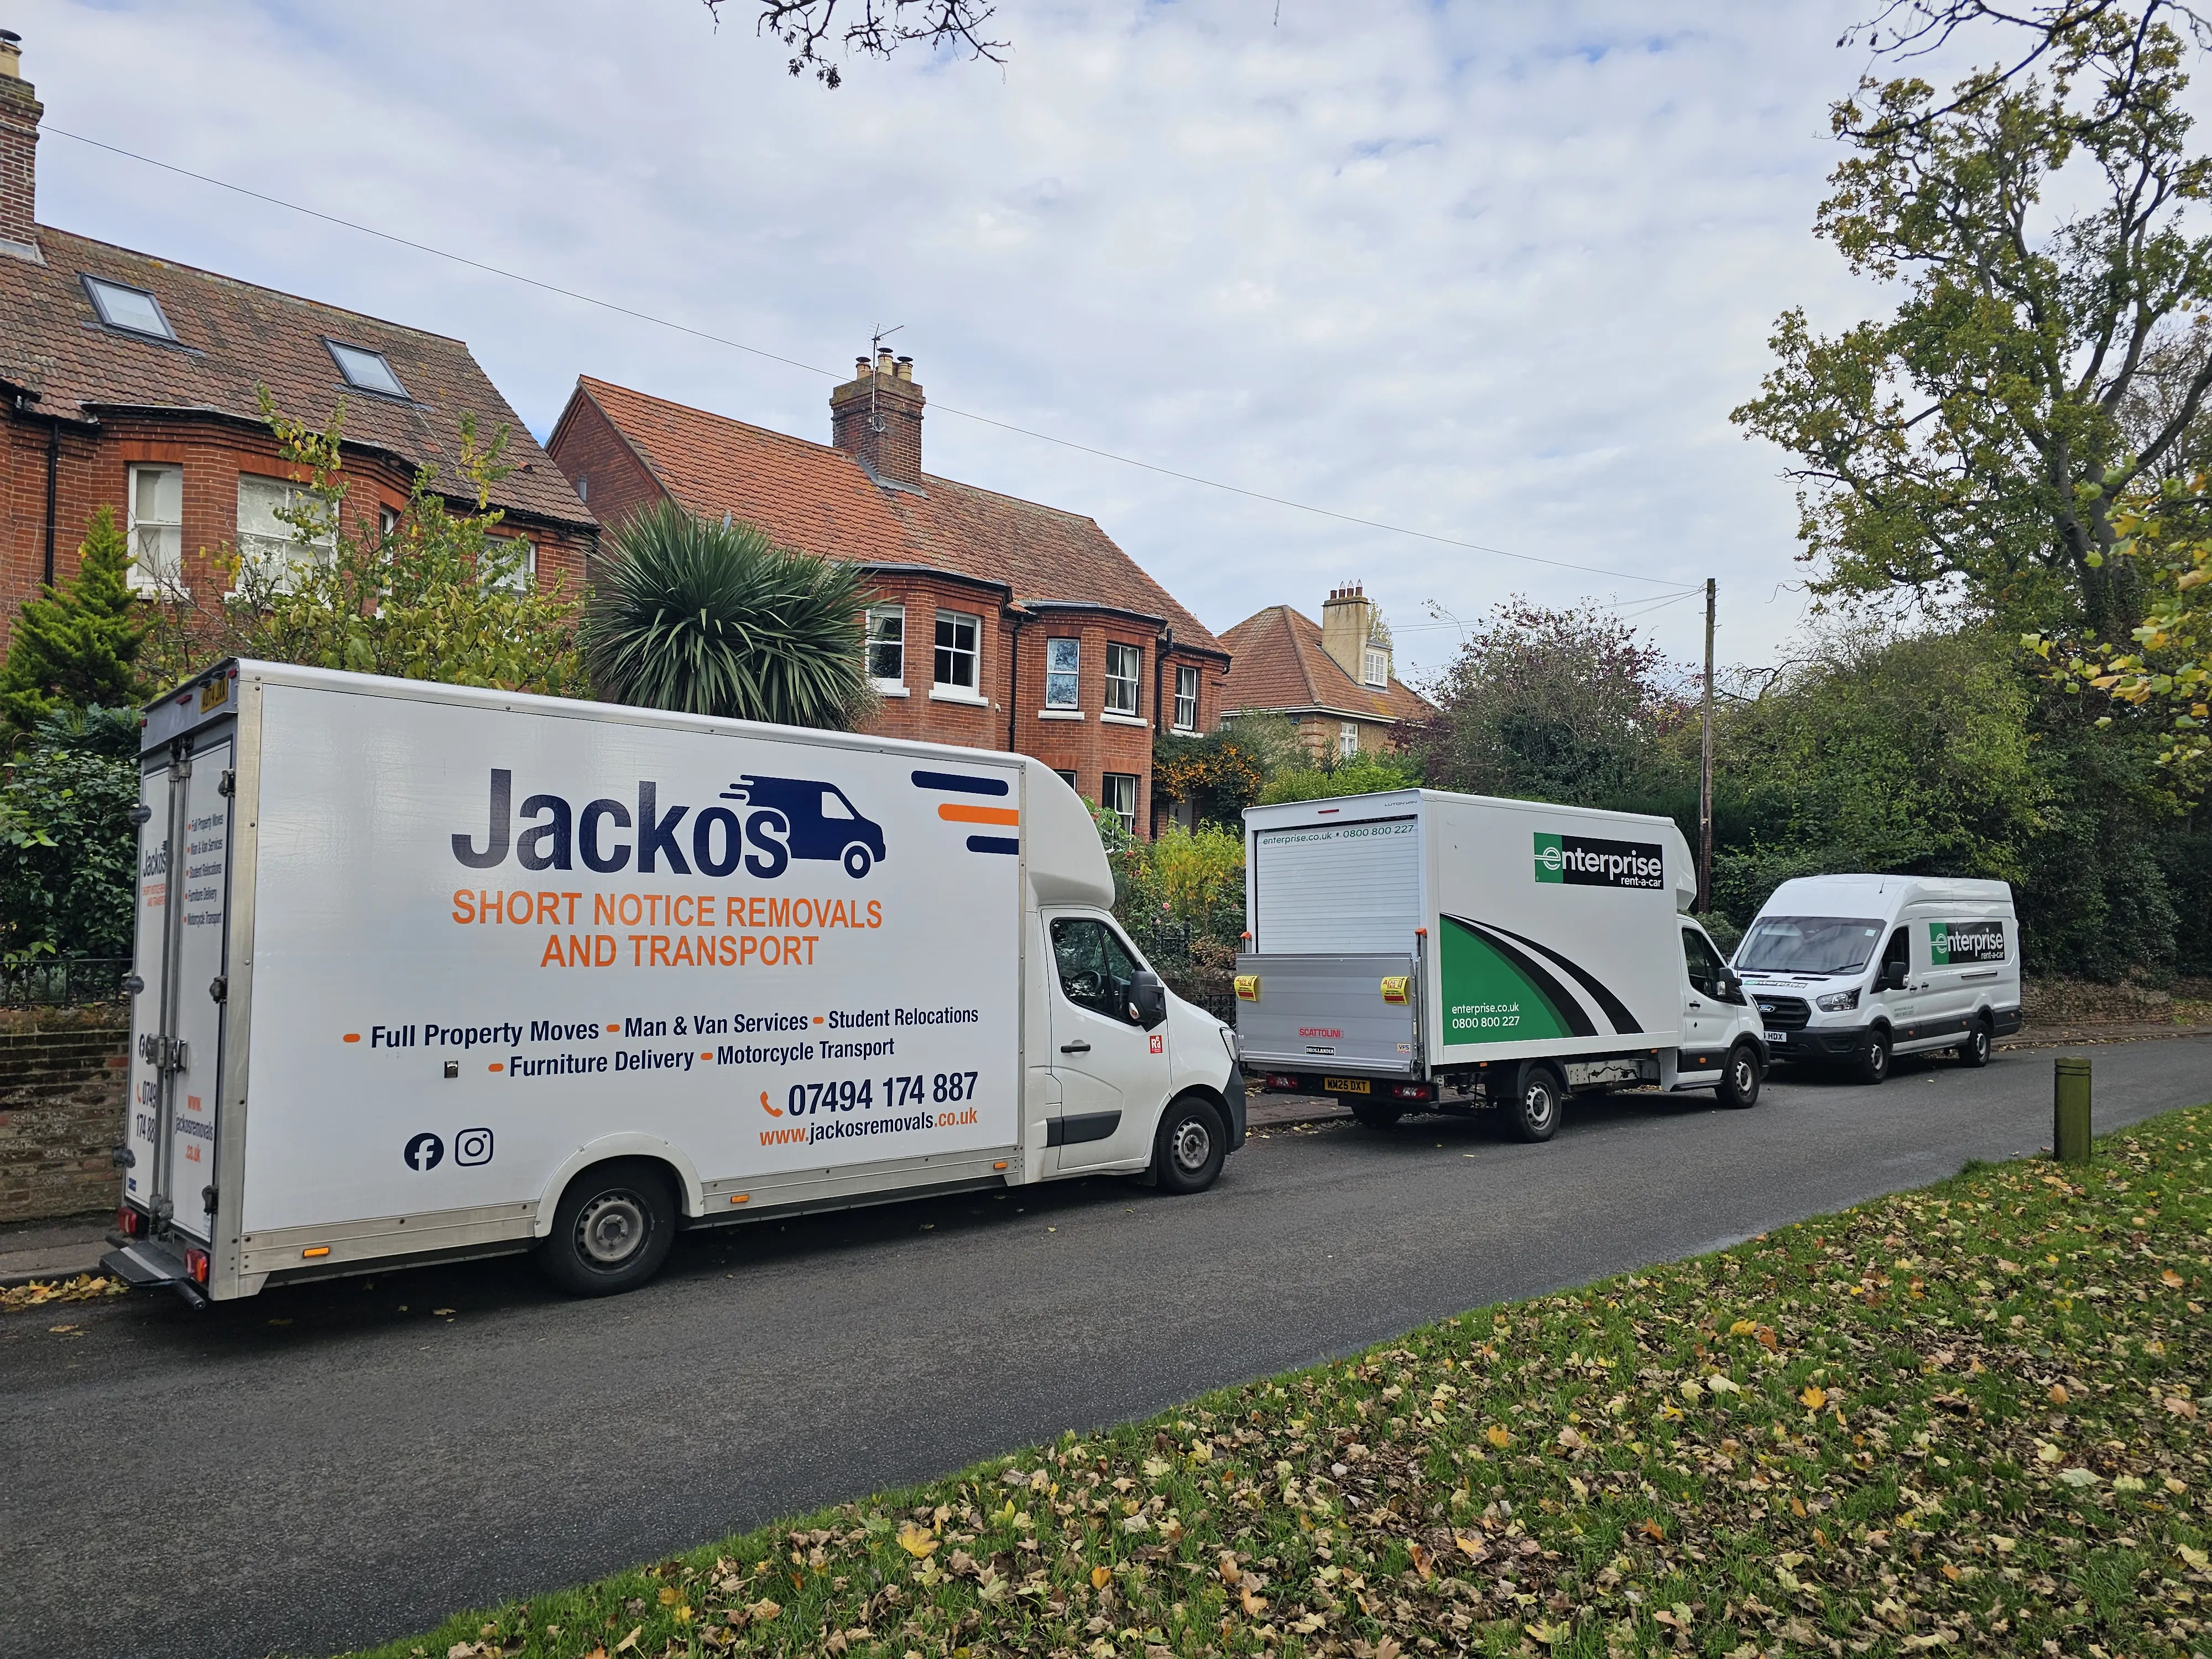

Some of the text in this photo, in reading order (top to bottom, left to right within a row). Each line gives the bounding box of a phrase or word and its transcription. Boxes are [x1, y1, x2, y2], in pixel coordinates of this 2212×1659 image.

[451, 768, 790, 879] Jackos
[1263, 825, 1414, 845] enterprise.co.uk 0800 800 227
[1535, 847, 1661, 880] enterprise
[1621, 877, 1661, 887] rent-a-car
[453, 889, 882, 928] SHORT NOTICE REMOVALS
[541, 935, 818, 967] AND TRANSPORT
[1931, 928, 2004, 957] enterprise
[1981, 951, 2004, 959] rent-a-car
[1452, 1001, 1520, 1016] enterprise.co.uk
[1452, 1016, 1520, 1029] 0800 800 227
[371, 1006, 979, 1050] Full Property Moves Man & Van Services Student Relocations
[1300, 1028, 1340, 1038] SCATTOLINI
[1768, 1032, 1783, 1041] HDX
[510, 1037, 895, 1077] Furniture Delivery Motorcycle Transport
[142, 1080, 156, 1109] 0749
[788, 1071, 978, 1117] 07494 174 887
[1350, 1081, 1366, 1092] DXT
[137, 1112, 155, 1144] 174 88
[760, 1107, 977, 1146] www.jackosremovals.co.uk
